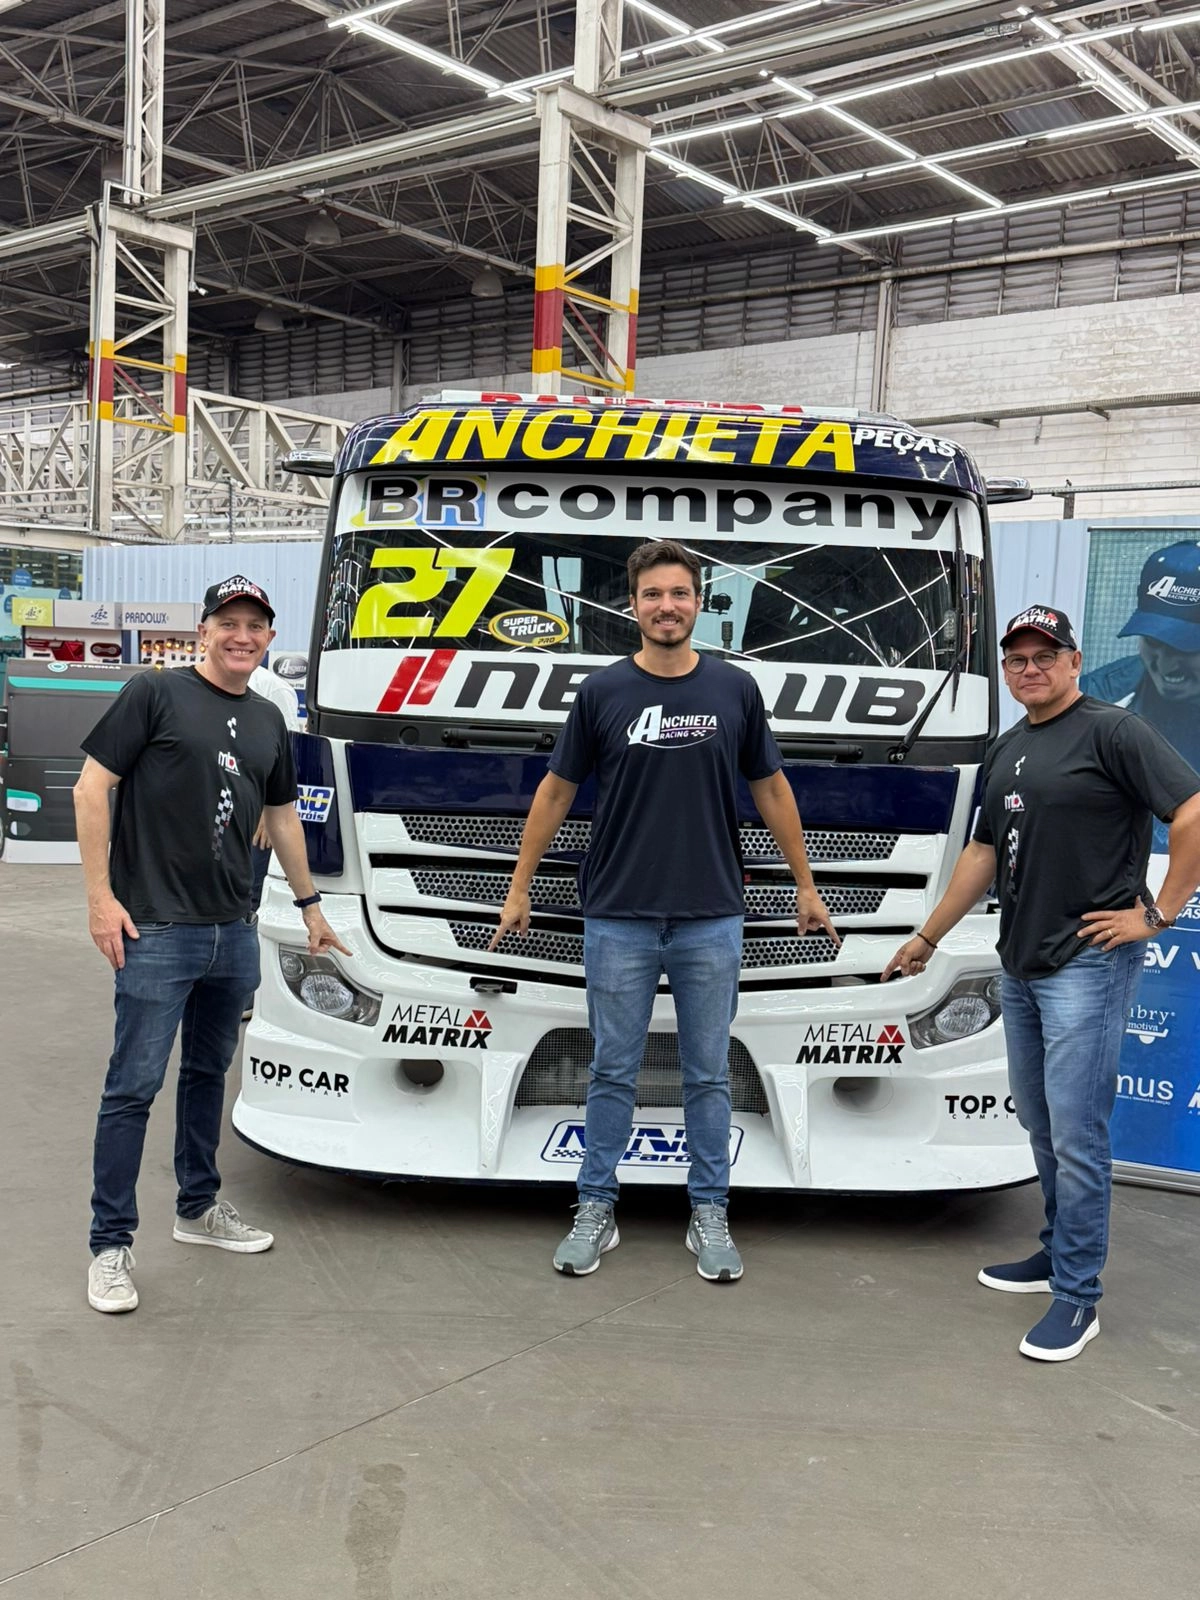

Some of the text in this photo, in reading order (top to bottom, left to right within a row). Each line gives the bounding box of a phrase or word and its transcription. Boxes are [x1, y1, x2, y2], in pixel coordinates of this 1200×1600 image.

[370, 409, 957, 472] ANCHIETA PEÇAS
[367, 477, 953, 541] BR company
[217, 584, 263, 599] MATRIX
[351, 547, 515, 639] 27
[503, 615, 538, 628] SUPER
[508, 621, 556, 637] TRUCK
[537, 637, 555, 645] PRO
[628, 705, 717, 745] ANCHIETA
[660, 730, 689, 740] RACING
[391, 1004, 463, 1027] METAL
[382, 1024, 492, 1049] MATRIX
[804, 1023, 876, 1043] METAL
[795, 1045, 905, 1064] MATRIX
[250, 1056, 350, 1093] TOP CAR
[253, 1076, 342, 1098] CAMPINAS
[945, 1095, 997, 1114] TOP
